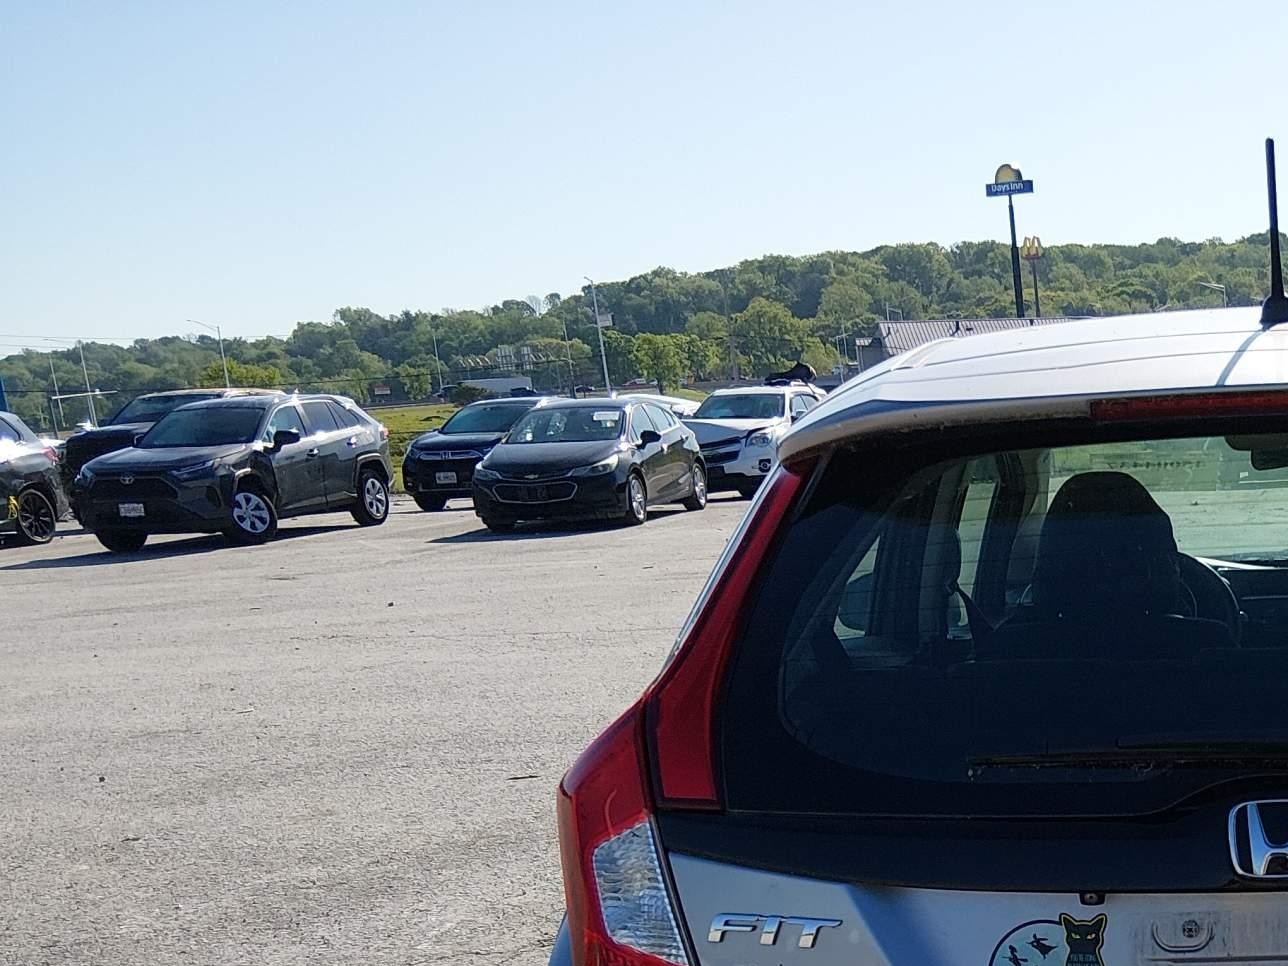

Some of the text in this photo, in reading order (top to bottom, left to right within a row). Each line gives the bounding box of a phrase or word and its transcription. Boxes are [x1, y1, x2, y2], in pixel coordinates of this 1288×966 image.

[991, 182, 1024, 193] Days Inn
[708, 912, 843, 949] FIT
